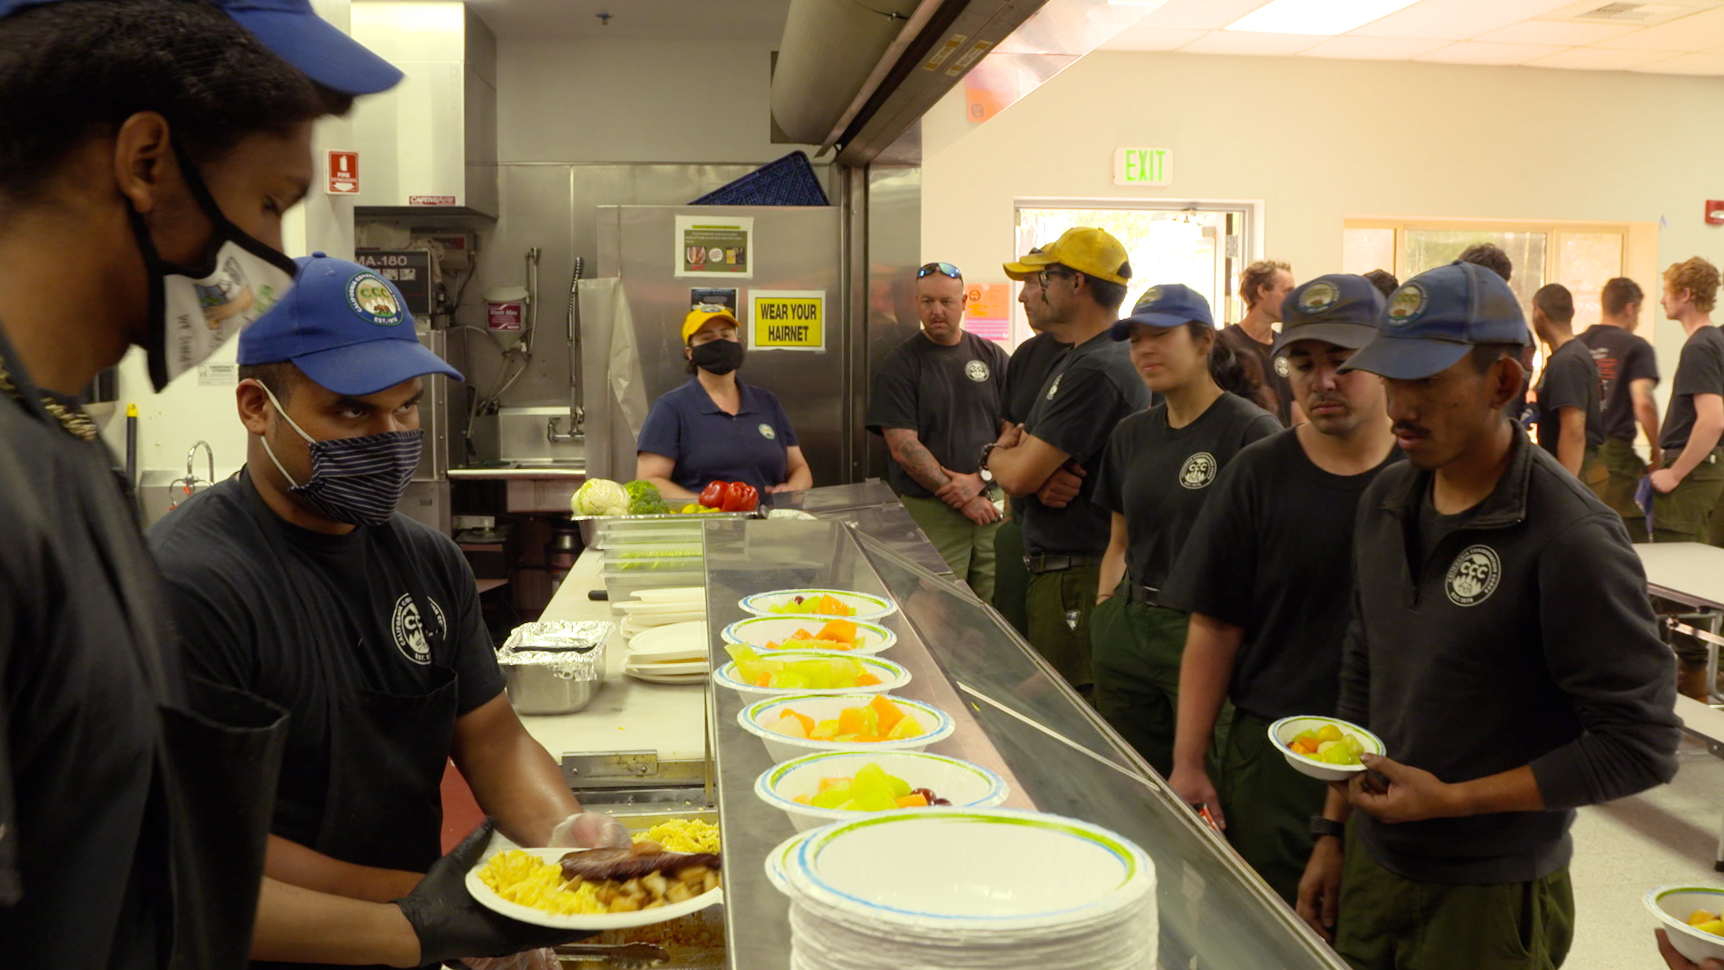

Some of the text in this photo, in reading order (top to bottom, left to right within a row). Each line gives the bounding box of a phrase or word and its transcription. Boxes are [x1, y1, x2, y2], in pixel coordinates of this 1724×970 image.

[1126, 149, 1166, 182] EXIT
[361, 287, 390, 298] CCC
[760, 303, 817, 321] WEAR YOUR
[768, 325, 809, 342] HAIRNET
[1460, 561, 1489, 579] CCC
